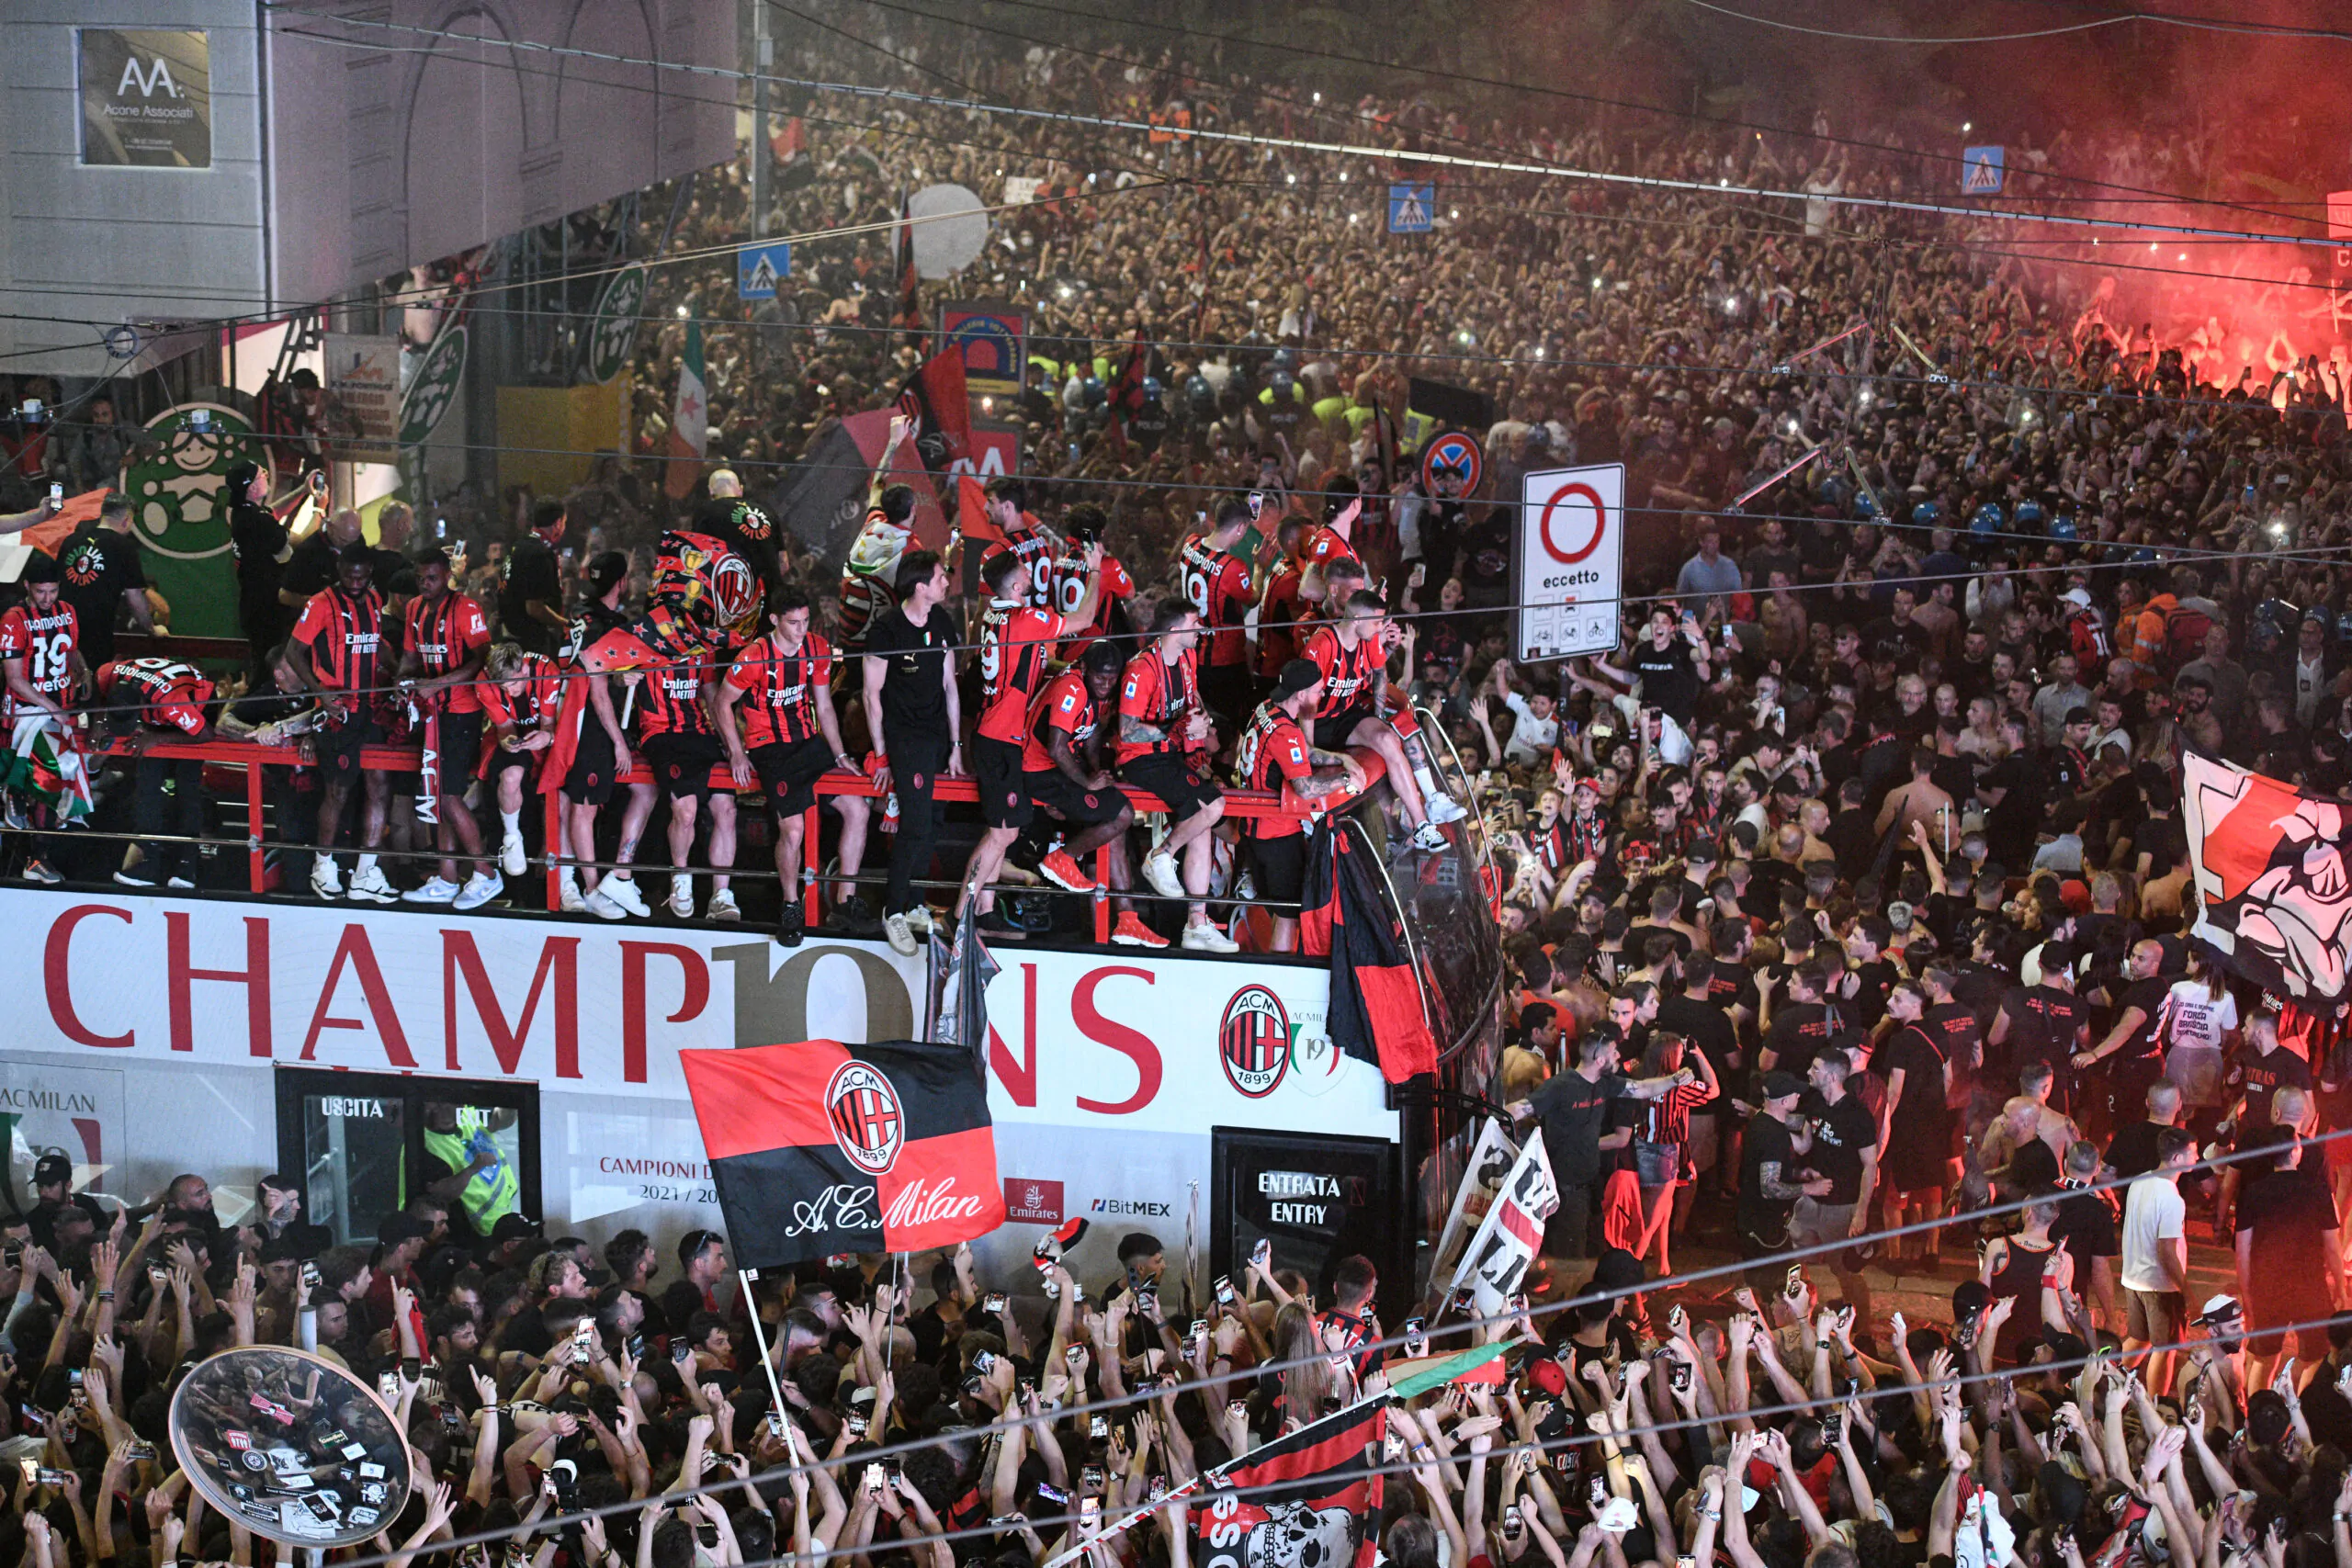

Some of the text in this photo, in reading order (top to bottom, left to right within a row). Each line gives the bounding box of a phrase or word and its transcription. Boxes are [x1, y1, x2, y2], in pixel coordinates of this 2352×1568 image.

[104, 104, 193, 118] Acone Associati
[1179, 561, 1209, 618] 19
[1543, 570, 1600, 589] eccetto
[24, 612, 74, 632] CHAMPIONS
[33, 633, 73, 679] 19
[113, 664, 174, 694] CHAMPIONS
[414, 748, 439, 825] ACM
[1236, 993, 1276, 1016] ACM
[1305, 1038, 1326, 1061] 19
[840, 1071, 880, 1094] ACM
[1238, 1071, 1272, 1086] 1899
[322, 1097, 384, 1119] USCITA
[856, 1148, 888, 1162] 1899
[599, 1156, 697, 1182] CAMPIONI
[639, 1183, 679, 1201] 2021
[1258, 1171, 1341, 1198] ENTRATA
[871, 1176, 983, 1231] Milan
[1010, 1205, 1058, 1220] Emirates
[1109, 1200, 1171, 1217] BitMEX
[1271, 1201, 1328, 1225] ENTRY
